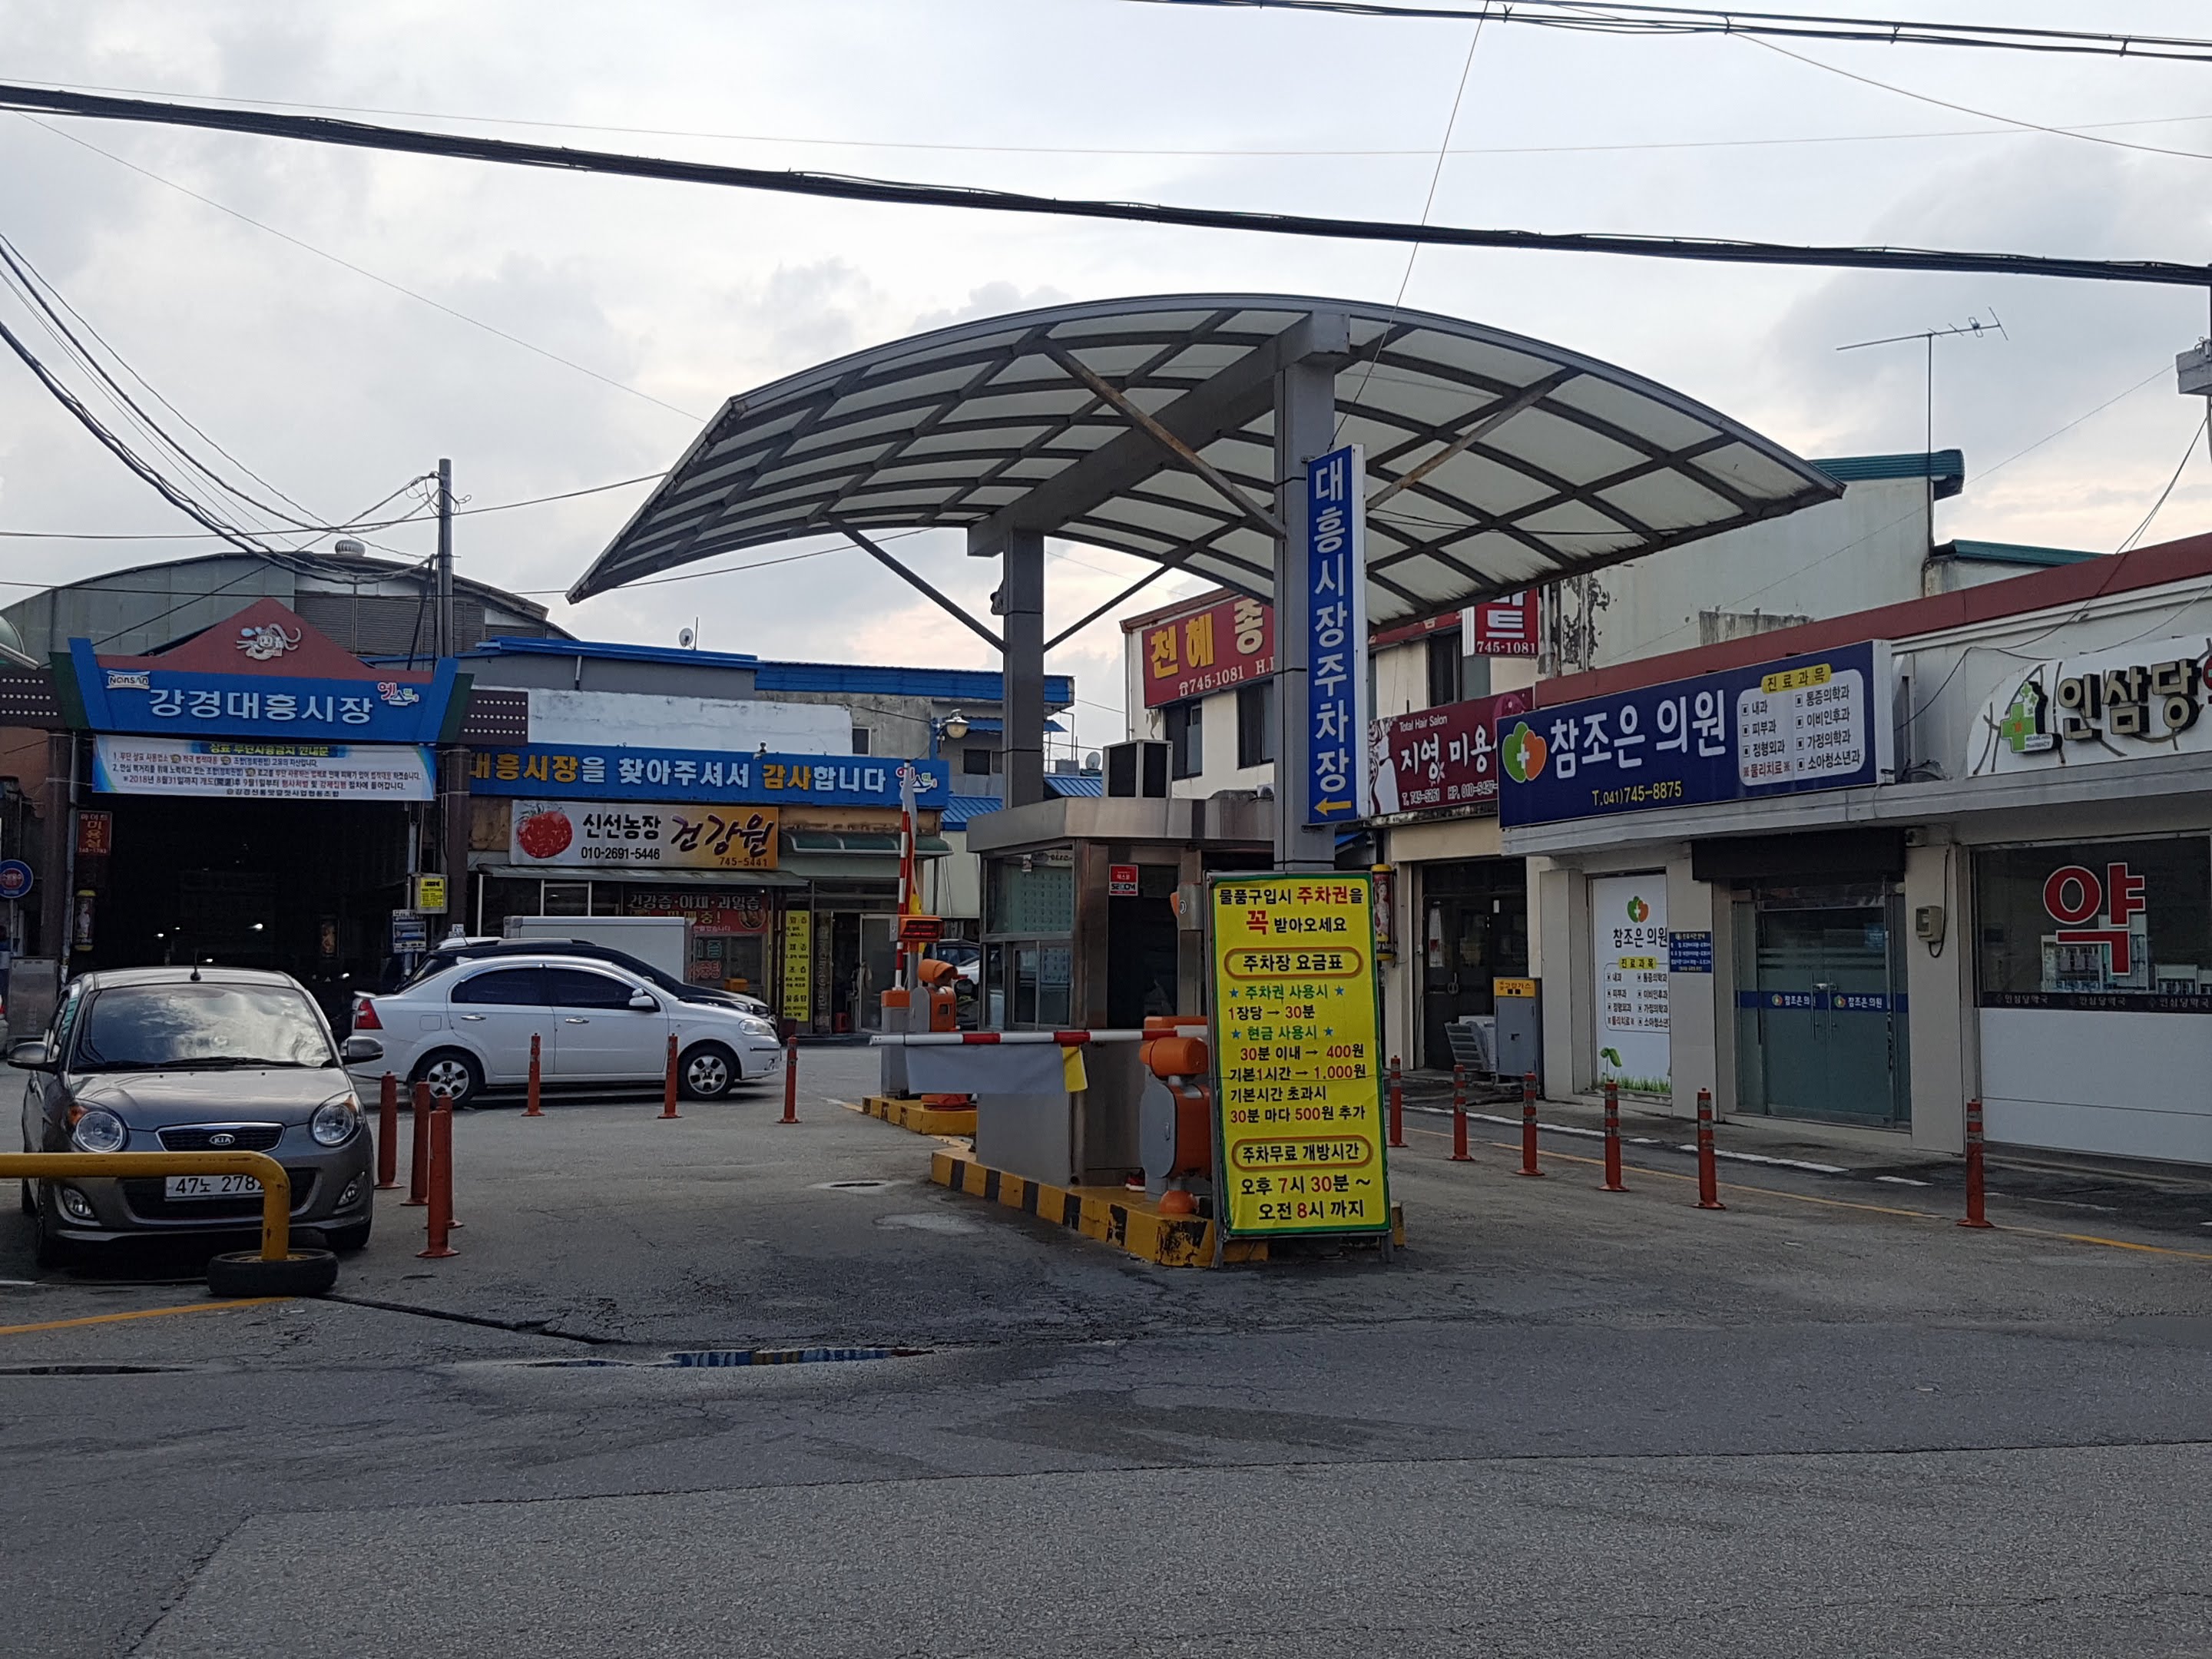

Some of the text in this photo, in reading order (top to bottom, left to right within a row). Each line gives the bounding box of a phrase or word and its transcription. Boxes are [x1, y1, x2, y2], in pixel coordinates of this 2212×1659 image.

[1313, 457, 1349, 793] 대흥시장주차장
[1477, 641, 1536, 654] 745-1081
[1189, 665, 1244, 694] 745-1081
[1767, 667, 1825, 691] 진료과목
[1806, 684, 1849, 707] 통증의학과
[2058, 659, 2200, 740] 인삼당
[149, 690, 373, 724] 강경대흥시장
[1752, 700, 1768, 716] 내과
[1399, 714, 1447, 732] Total Hair Salon
[1806, 707, 1850, 727] 이비인후과
[1550, 690, 1726, 779] 참조은 의원
[1752, 719, 1777, 736] 피부과
[1753, 740, 1785, 757] 정형외과
[1807, 729, 1851, 750] 가정의학과
[1401, 725, 1497, 780] 지영 미용
[1808, 749, 1860, 770] 소아청소년과
[469, 752, 886, 793] 대흥시장을 찾아주셔서 감사합니다
[582, 813, 774, 856] 신선농장 건강원
[581, 846, 661, 859] 010-2691-5446
[719, 856, 768, 868] 745-5441
[1219, 886, 1363, 905] 물품구입시 주차권을
[1246, 910, 1346, 935] 꼭 받아오세요
[2043, 863, 2146, 976] 약
[1613, 927, 1667, 948] 참조은 의원
[1243, 954, 1343, 972] 주차장 요금표
[1621, 959, 1654, 969] 진료과목
[1613, 972, 1621, 982] 내과
[1245, 984, 1328, 1002] 주차권 사용시
[1848, 997, 1868, 1008] 참조은
[1228, 1005, 1315, 1021] 1장당 30분
[1247, 1025, 1317, 1041] 현금 사용시
[1240, 1044, 1364, 1061] 30분 이내 400원
[1230, 1066, 1291, 1082] 기본1시간
[1230, 1085, 1326, 1103] 기본시간 초과시
[1230, 1105, 1366, 1124] 30분 마다 500원 추가
[1242, 1143, 1359, 1164] 주차무료 개방시간
[175, 1177, 210, 1194] 47노
[1241, 1177, 1273, 1195] 오후
[1278, 1176, 1304, 1194] 7시
[1310, 1174, 1349, 1192] 30분
[1258, 1200, 1363, 1220] 오전 8시 까지
